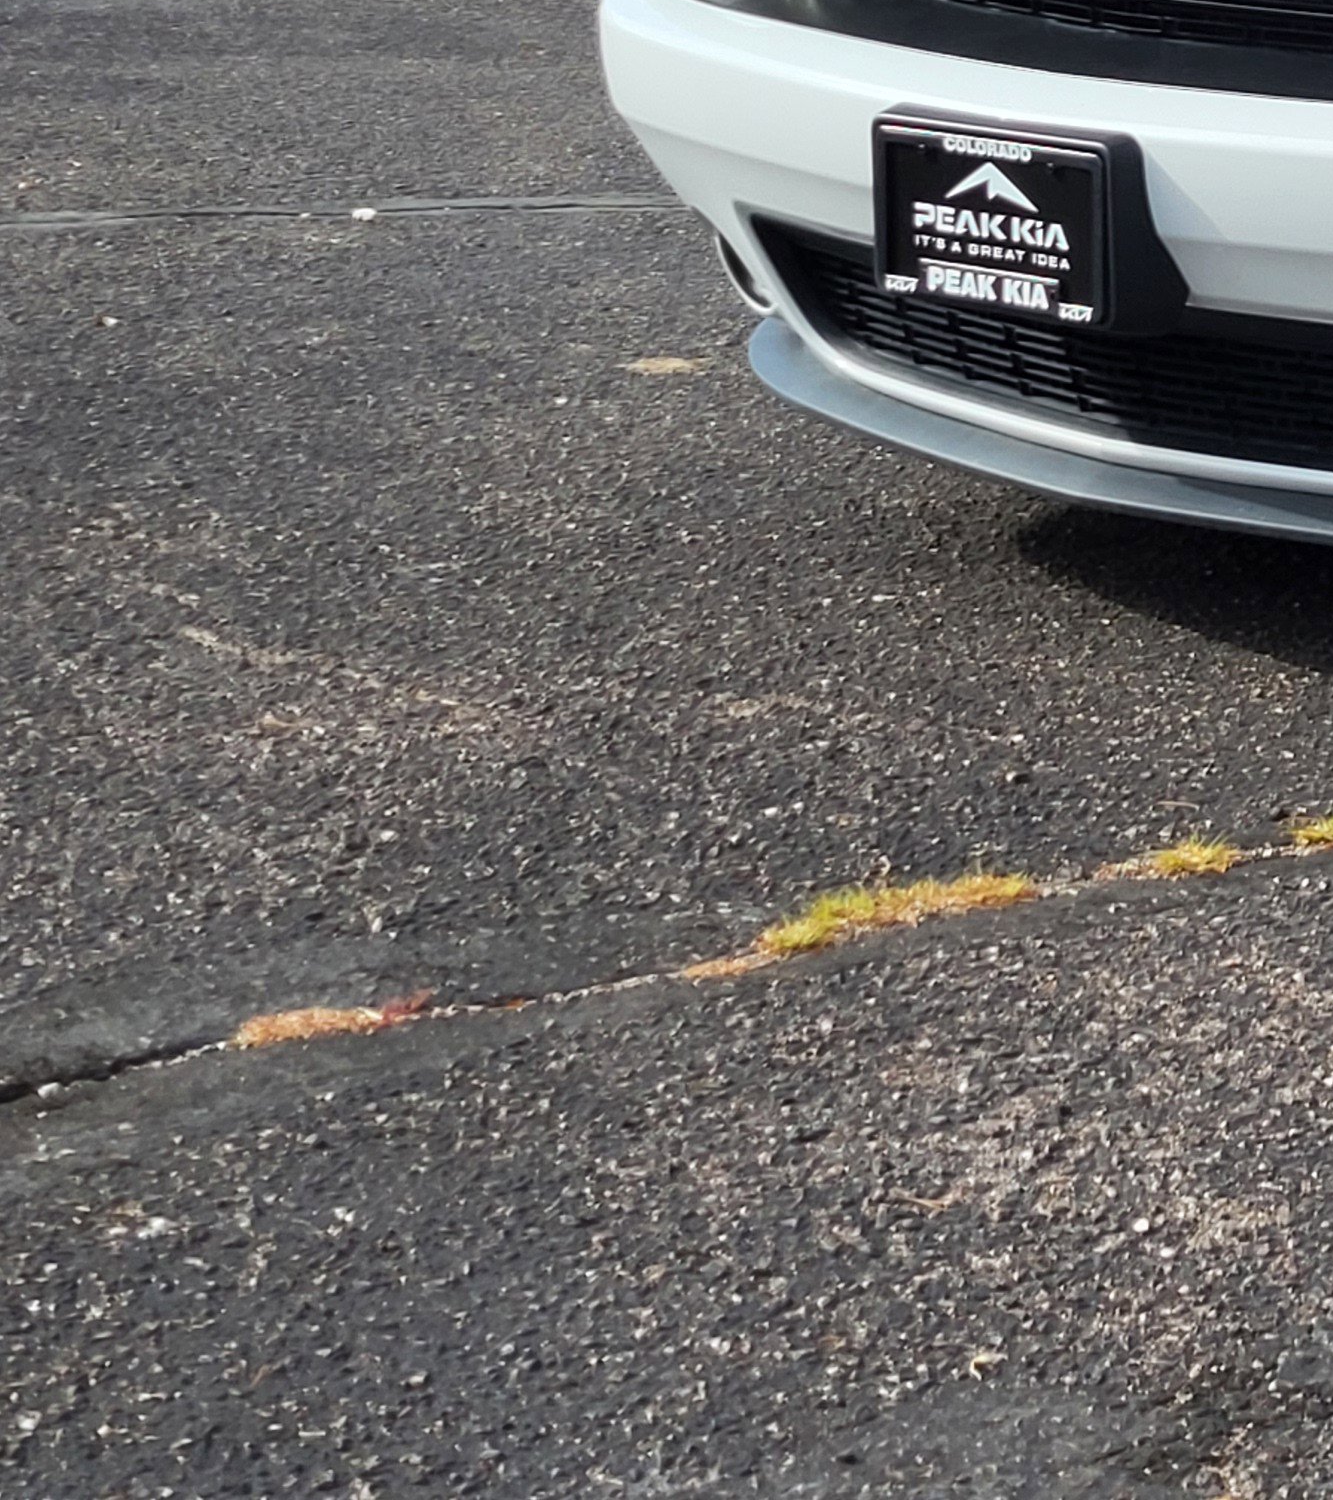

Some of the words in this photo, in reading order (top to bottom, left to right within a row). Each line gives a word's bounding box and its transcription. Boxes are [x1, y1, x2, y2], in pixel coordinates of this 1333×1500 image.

[942, 137, 1032, 162] COLORADO
[912, 201, 1007, 241] PEAK
[914, 234, 947, 250] IT'S
[951, 240, 962, 253] A
[967, 243, 1026, 262] GREAT
[1031, 253, 1071, 270] IDEA
[925, 265, 998, 301] PEAK
[1002, 278, 1050, 310] KIA
